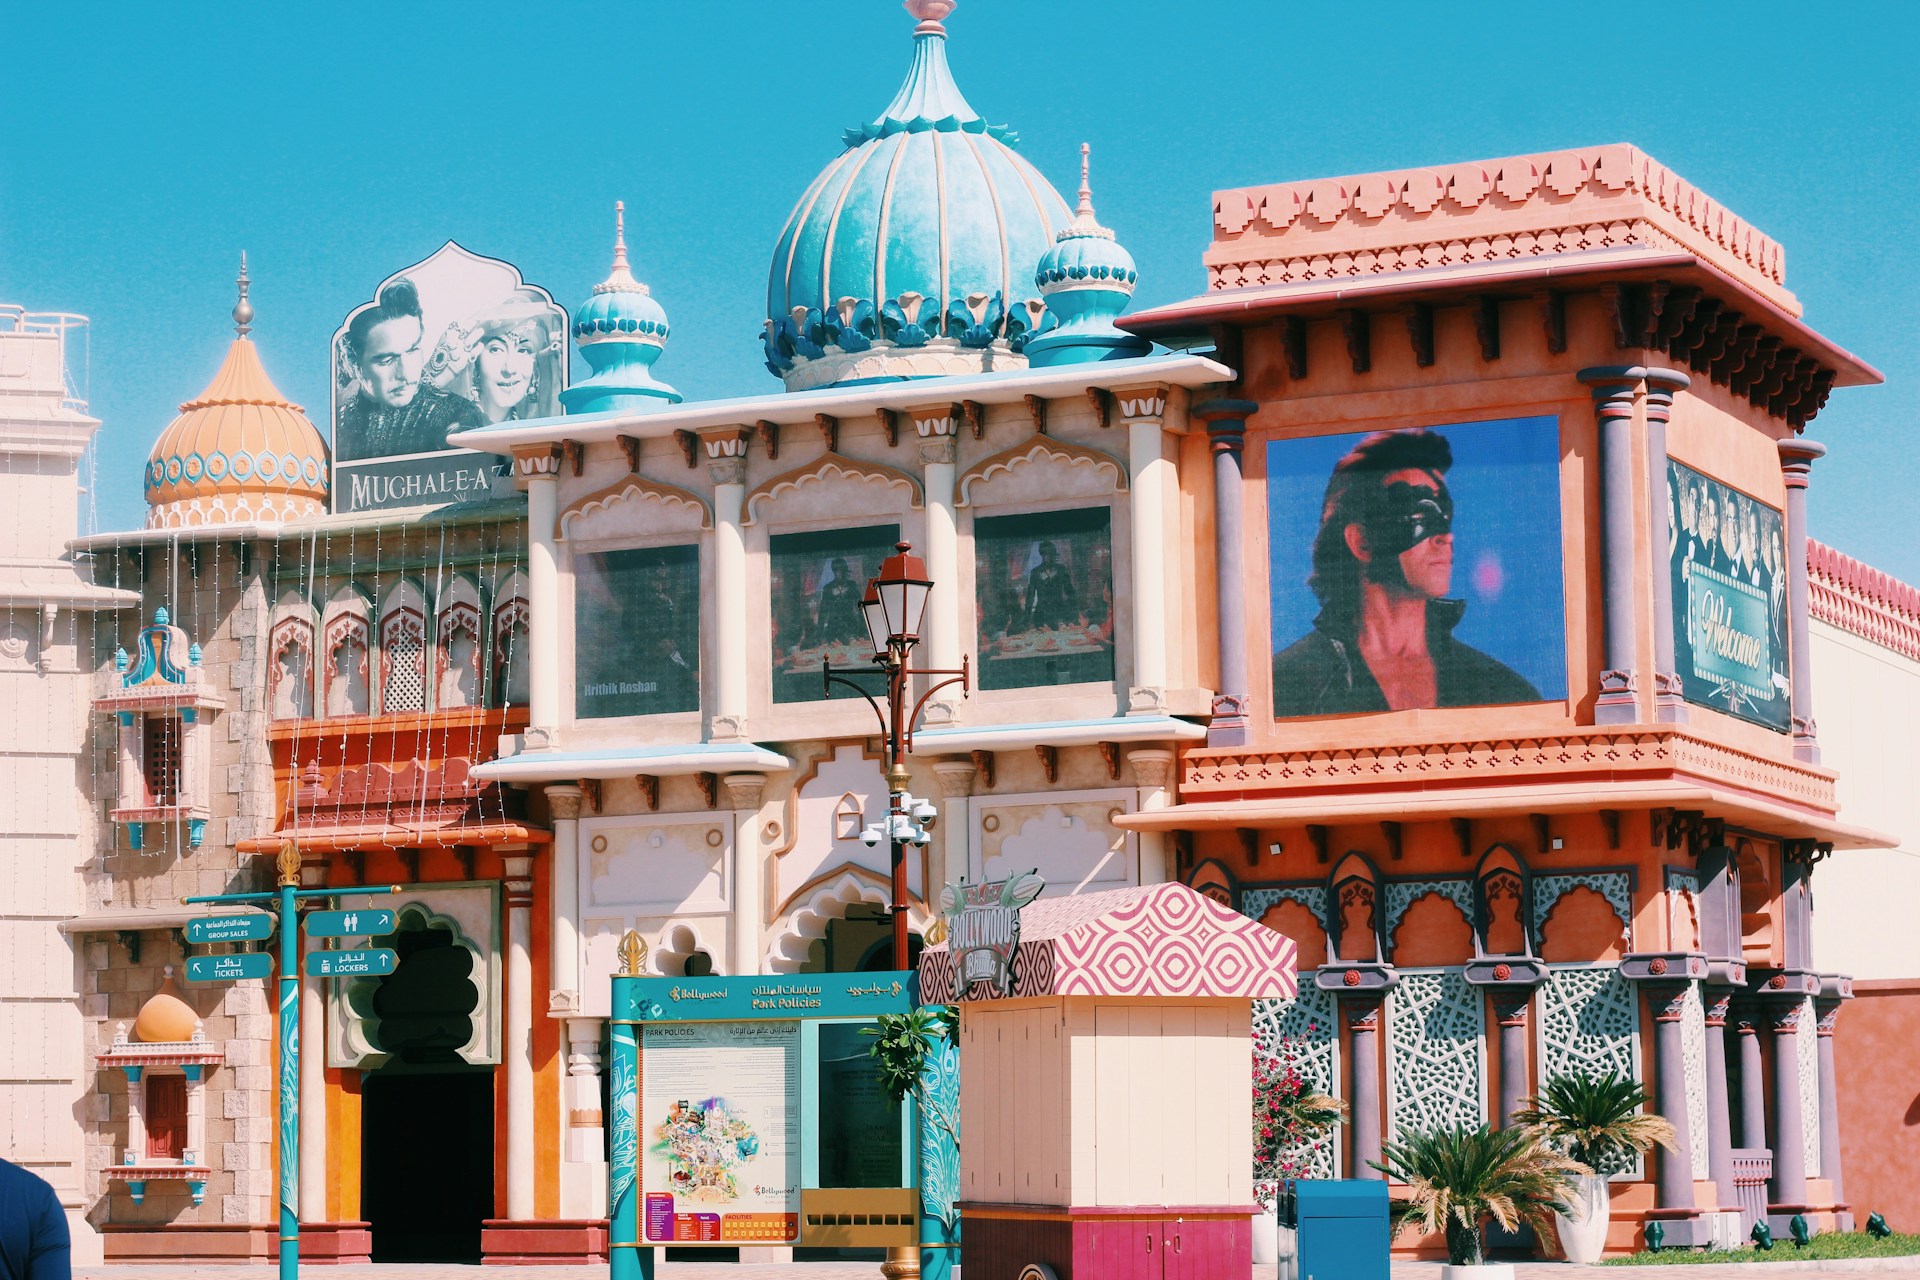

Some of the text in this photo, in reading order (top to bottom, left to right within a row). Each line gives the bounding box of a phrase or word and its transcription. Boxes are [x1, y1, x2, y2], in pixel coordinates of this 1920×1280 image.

[1701, 590, 1761, 669] Welcome
[584, 681, 657, 696] Hrithik Roshan
[952, 907, 1012, 949] BOLLYWOOD
[208, 931, 229, 939] GROUP
[334, 963, 369, 972] LOCKERS
[966, 950, 997, 979] Bhutta
[213, 969, 244, 977] TICKETS
[681, 988, 728, 1000] Bollywood
[752, 997, 822, 1009] Park Policies
[664, 1028, 695, 1036] POLICIES
[761, 1186, 795, 1196] Bollywood
